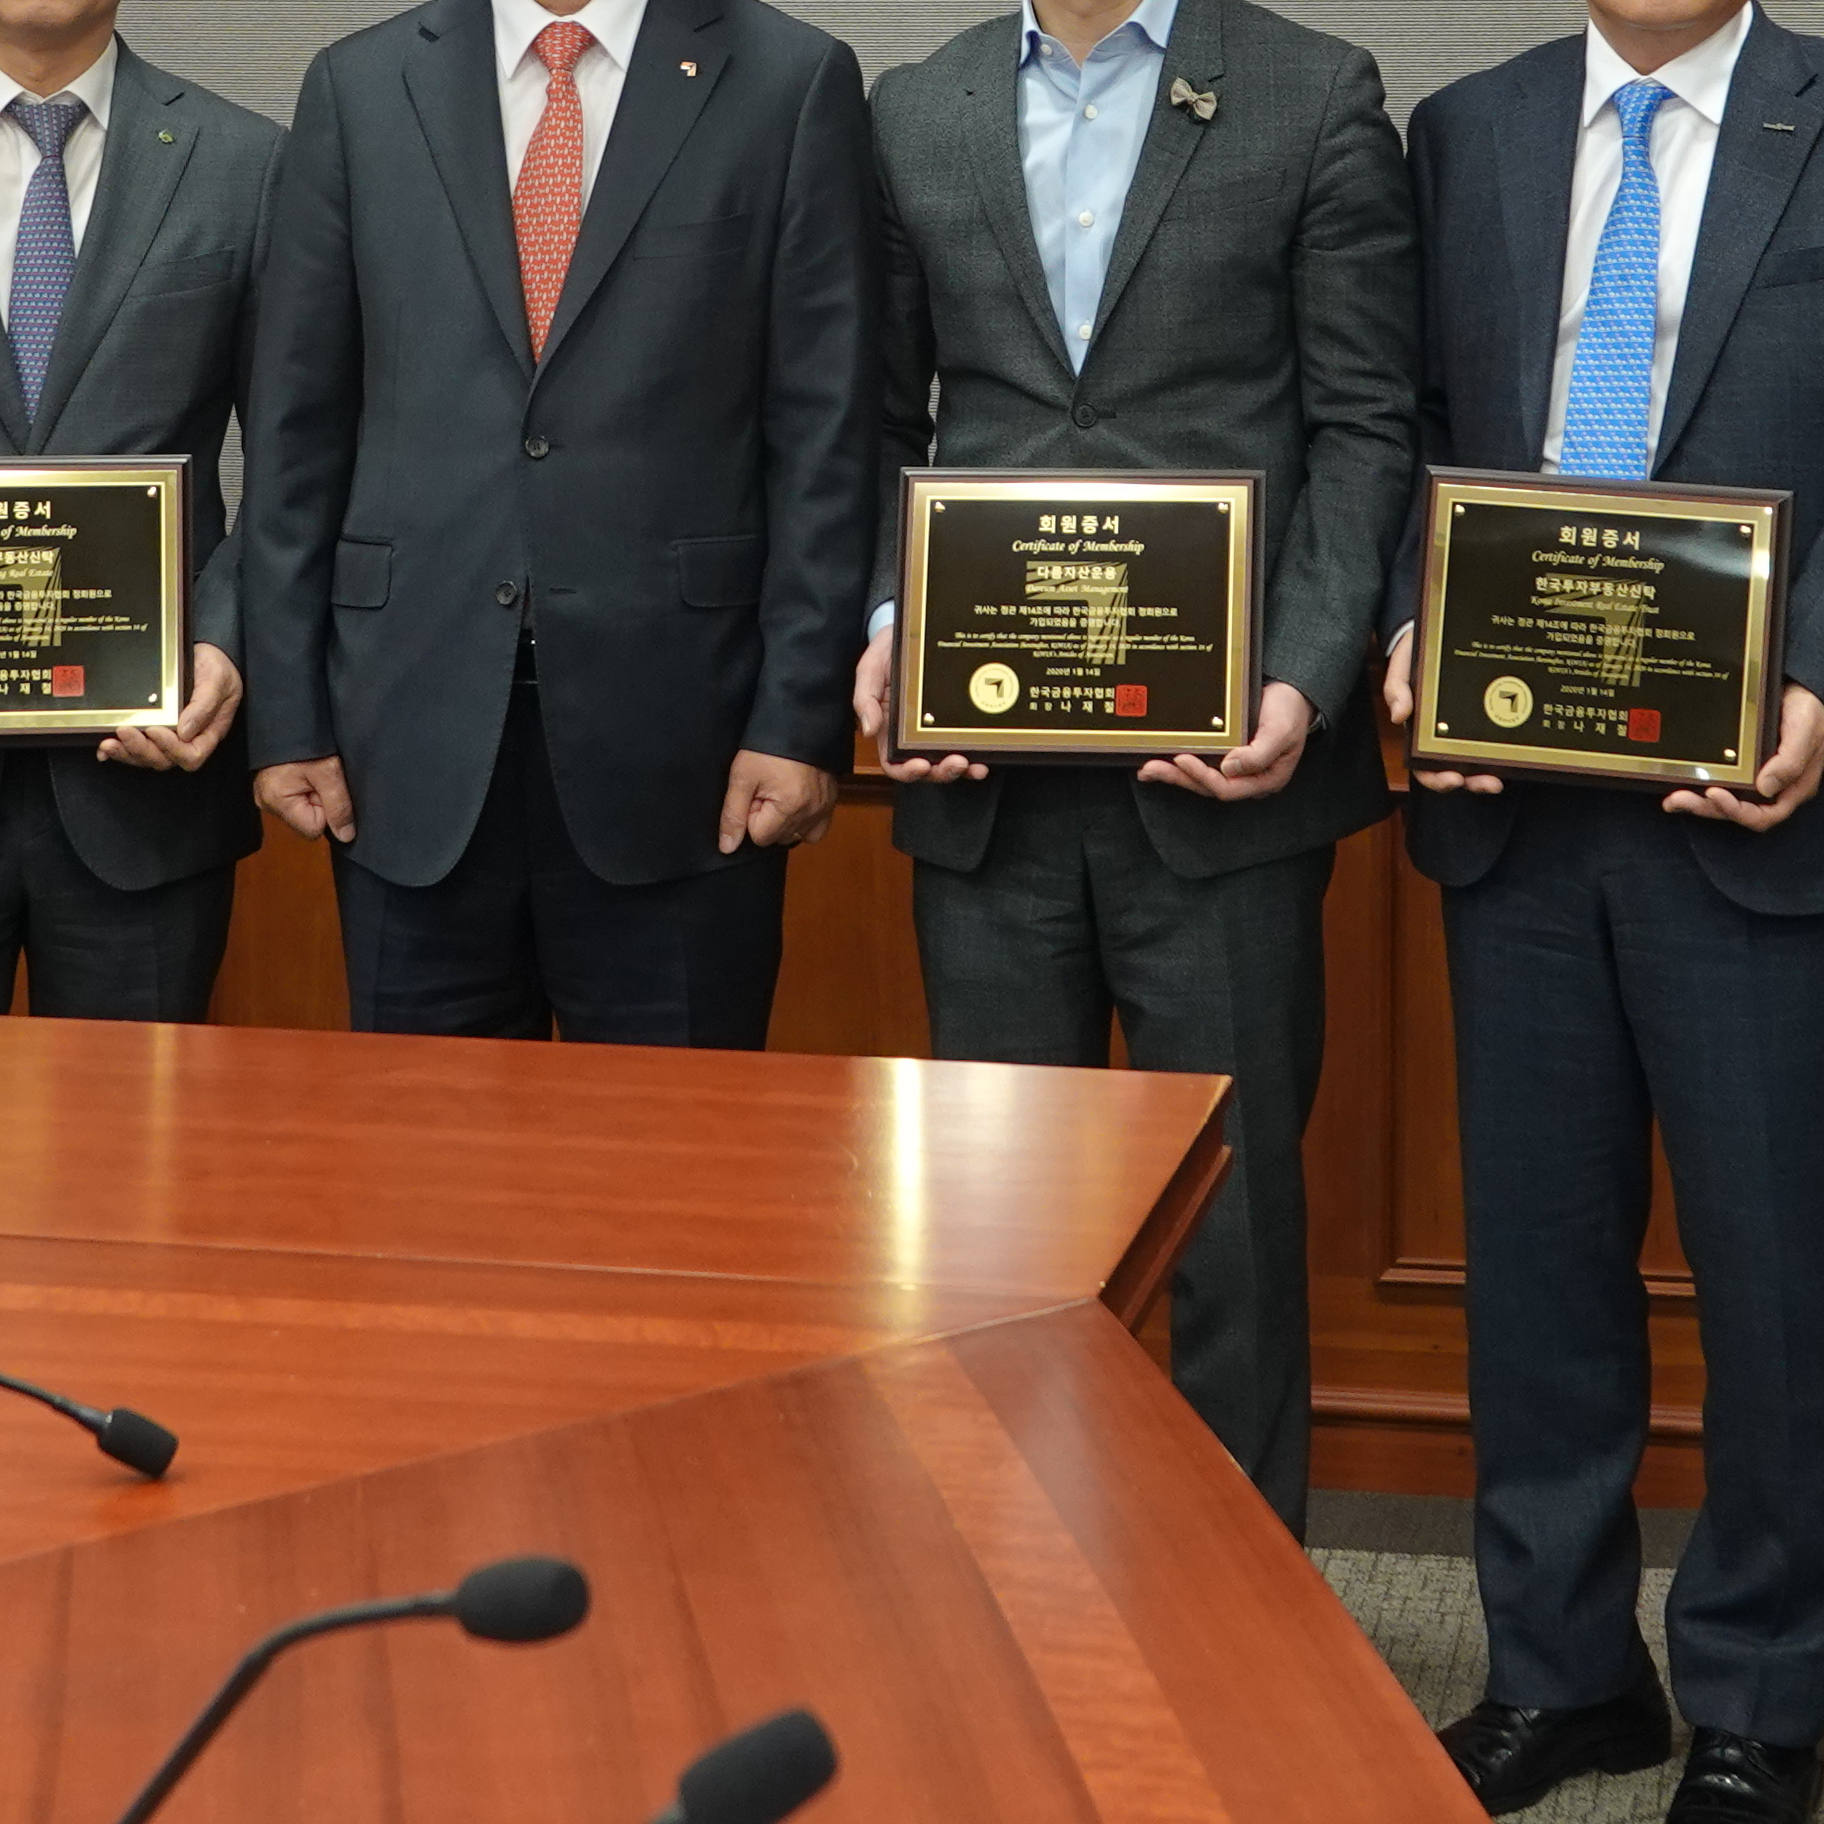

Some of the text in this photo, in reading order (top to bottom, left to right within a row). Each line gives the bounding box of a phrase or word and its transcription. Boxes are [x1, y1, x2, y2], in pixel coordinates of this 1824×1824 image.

[0, 524, 15, 540] of
[13, 523, 77, 540] Membership
[1037, 513, 1119, 535] 회원증서
[1011, 538, 1145, 556] Certificate of Membership
[1557, 523, 1641, 551] 회원증서
[1530, 548, 1665, 575] Certificate of Membership
[1036, 564, 1117, 580] 다름자산운용
[1534, 575, 1657, 601] 한국투자부동산신탁
[1028, 684, 1115, 700] 한국금융투자협회
